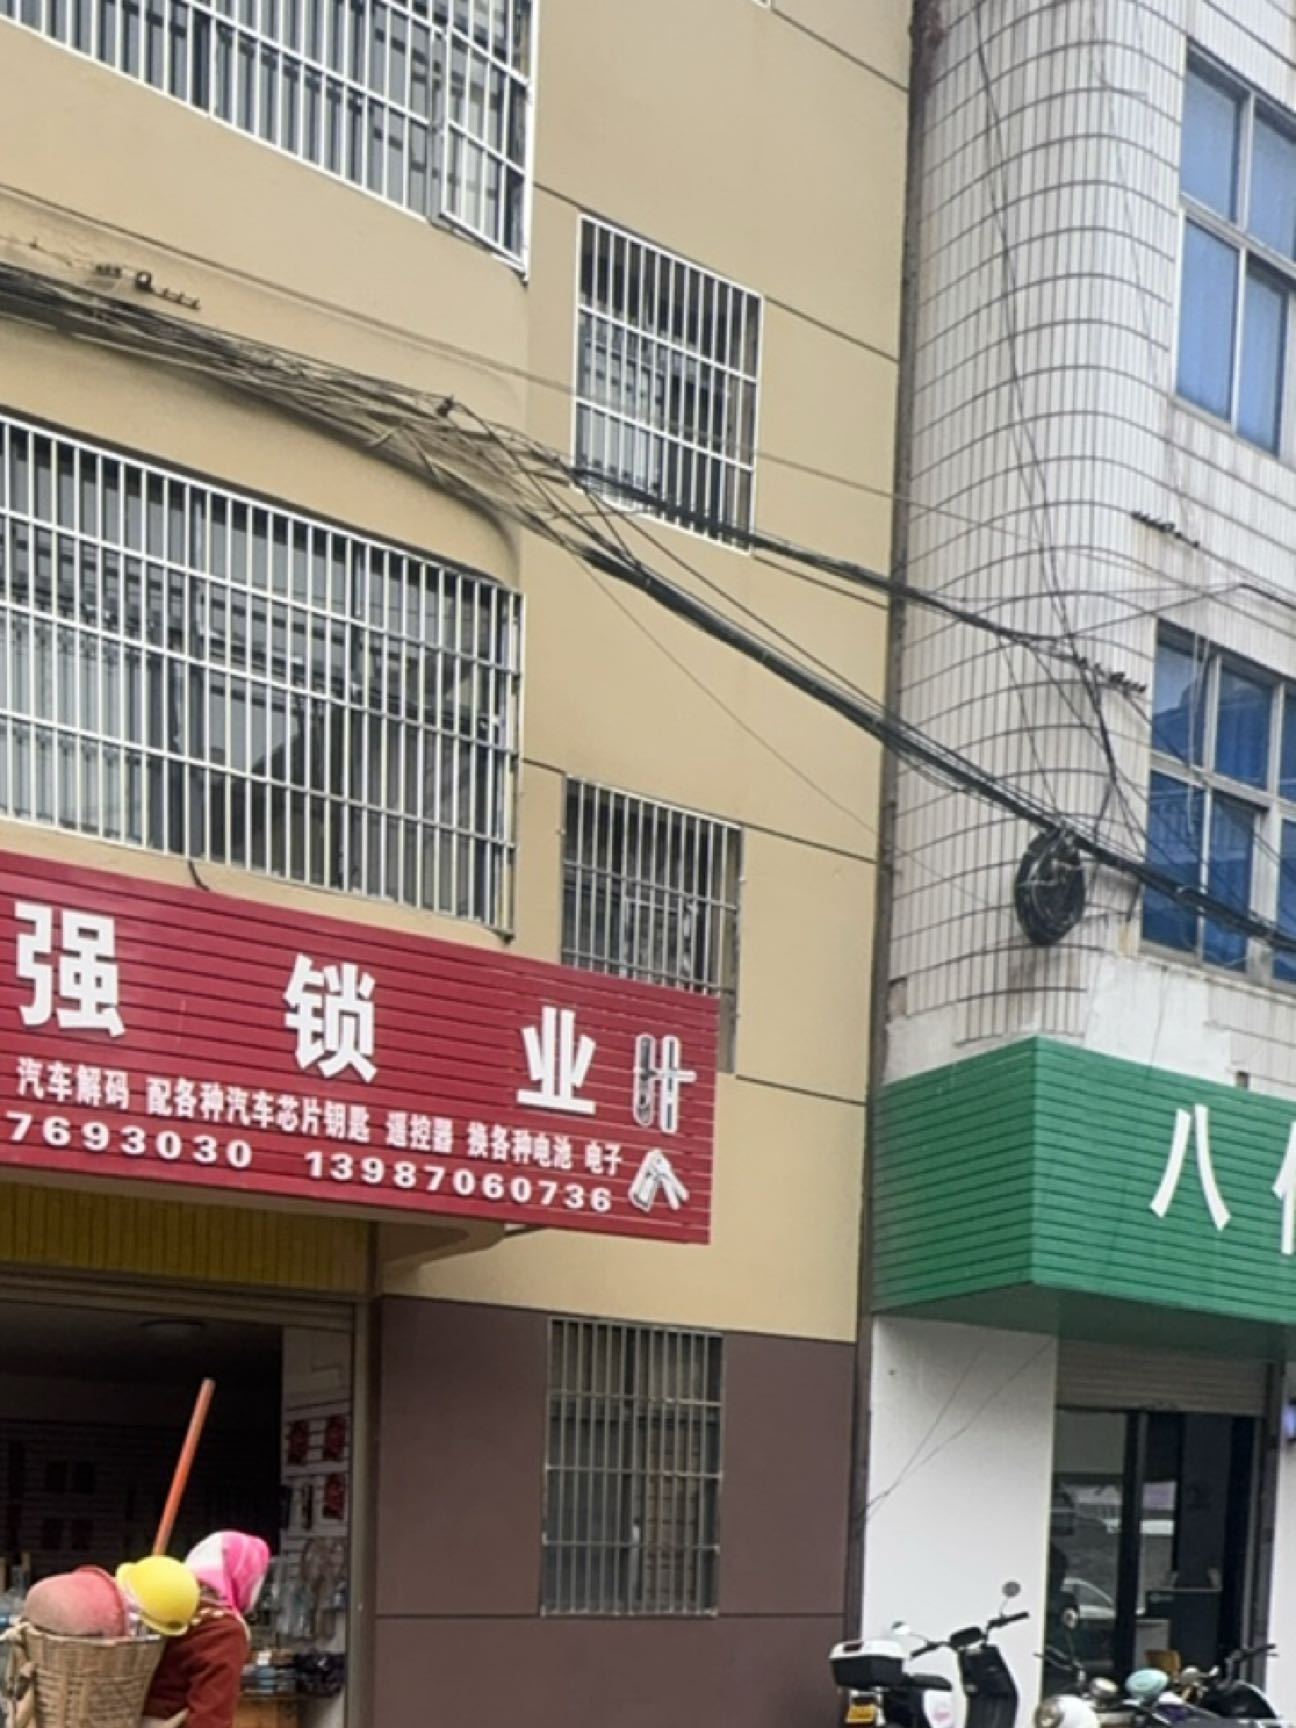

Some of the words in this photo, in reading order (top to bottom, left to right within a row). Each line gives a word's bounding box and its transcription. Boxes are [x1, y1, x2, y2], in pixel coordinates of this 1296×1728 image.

[17, 1057, 130, 1110] 汽车解码
[147, 1076, 370, 1143] 配各种汽车芯片钥匙
[467, 1122, 573, 1171] 换各种电池
[584, 1139, 623, 1176] 电子
[306, 1151, 612, 1213] 13987060736
[1150, 1103, 1296, 1256] 八
